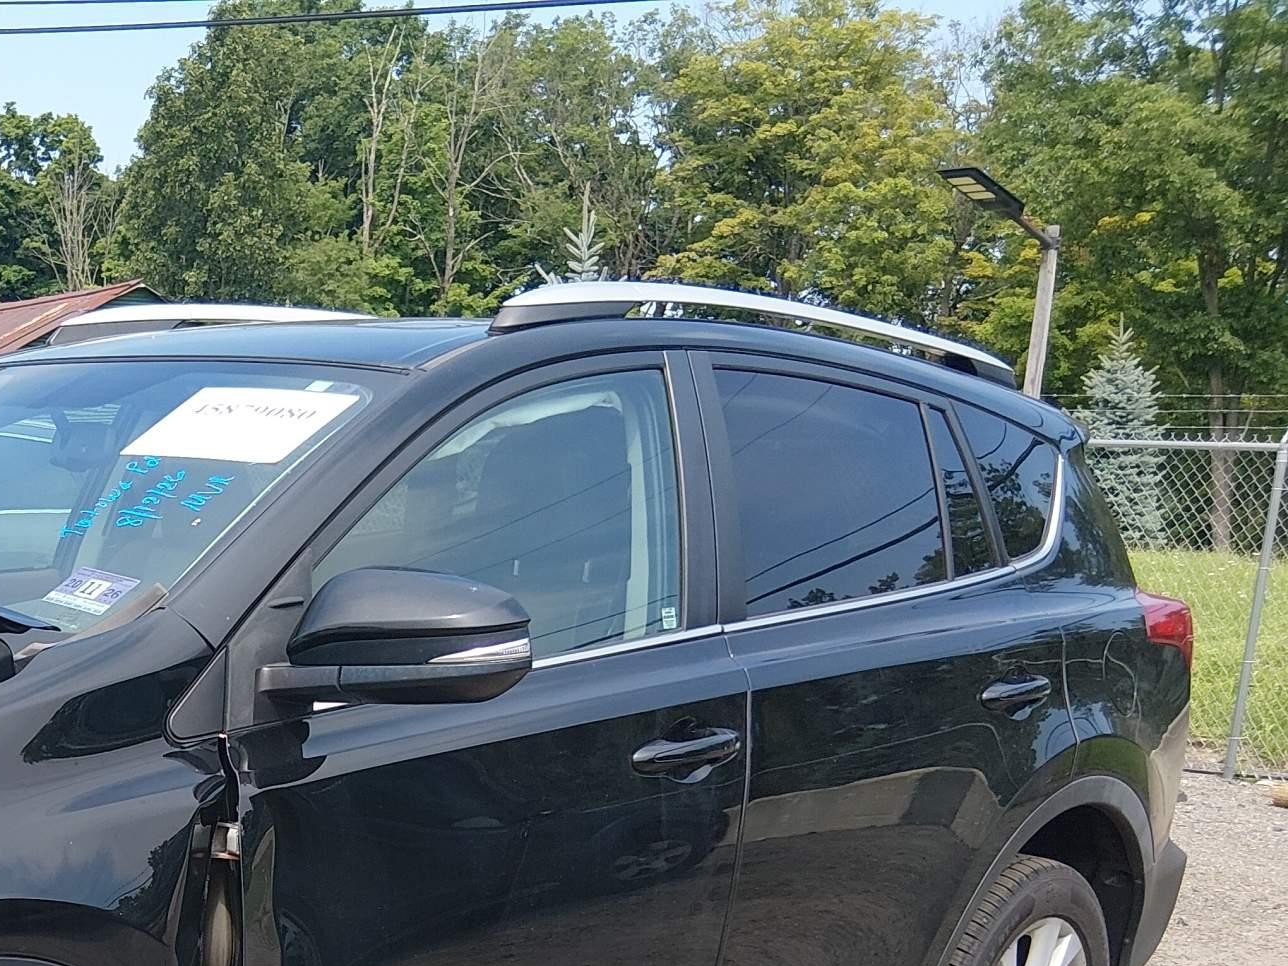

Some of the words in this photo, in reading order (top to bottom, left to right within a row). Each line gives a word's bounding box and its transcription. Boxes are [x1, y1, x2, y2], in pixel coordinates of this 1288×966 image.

[116, 470, 185, 528] 8/12/26
[65, 578, 83, 588] 20
[80, 581, 102, 595] 11
[103, 588, 122, 598] 26
